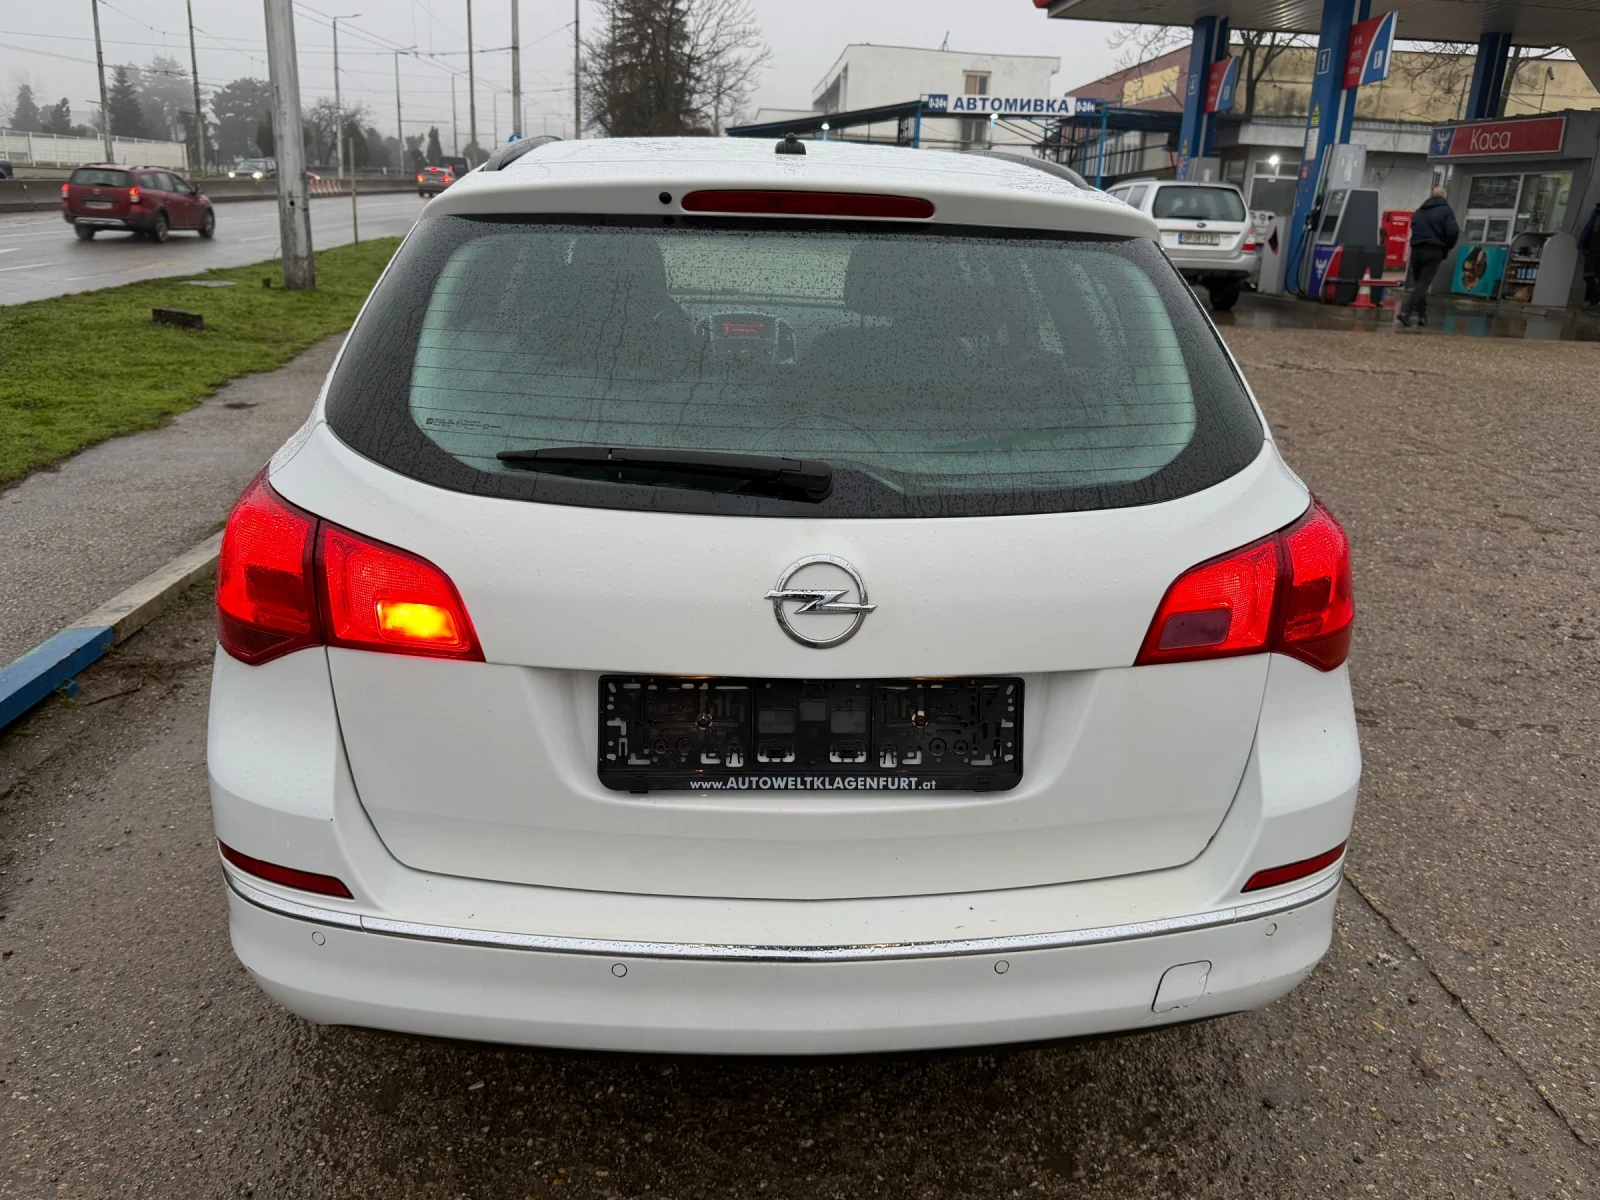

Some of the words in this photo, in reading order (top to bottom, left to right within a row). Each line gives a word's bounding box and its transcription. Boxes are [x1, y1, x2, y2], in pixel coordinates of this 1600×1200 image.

[953, 97, 1069, 113] АВТОМИВКА
[1470, 128, 1512, 151] Каса
[690, 776, 937, 790] www.AUTOWELTKLAGENFURT.at
